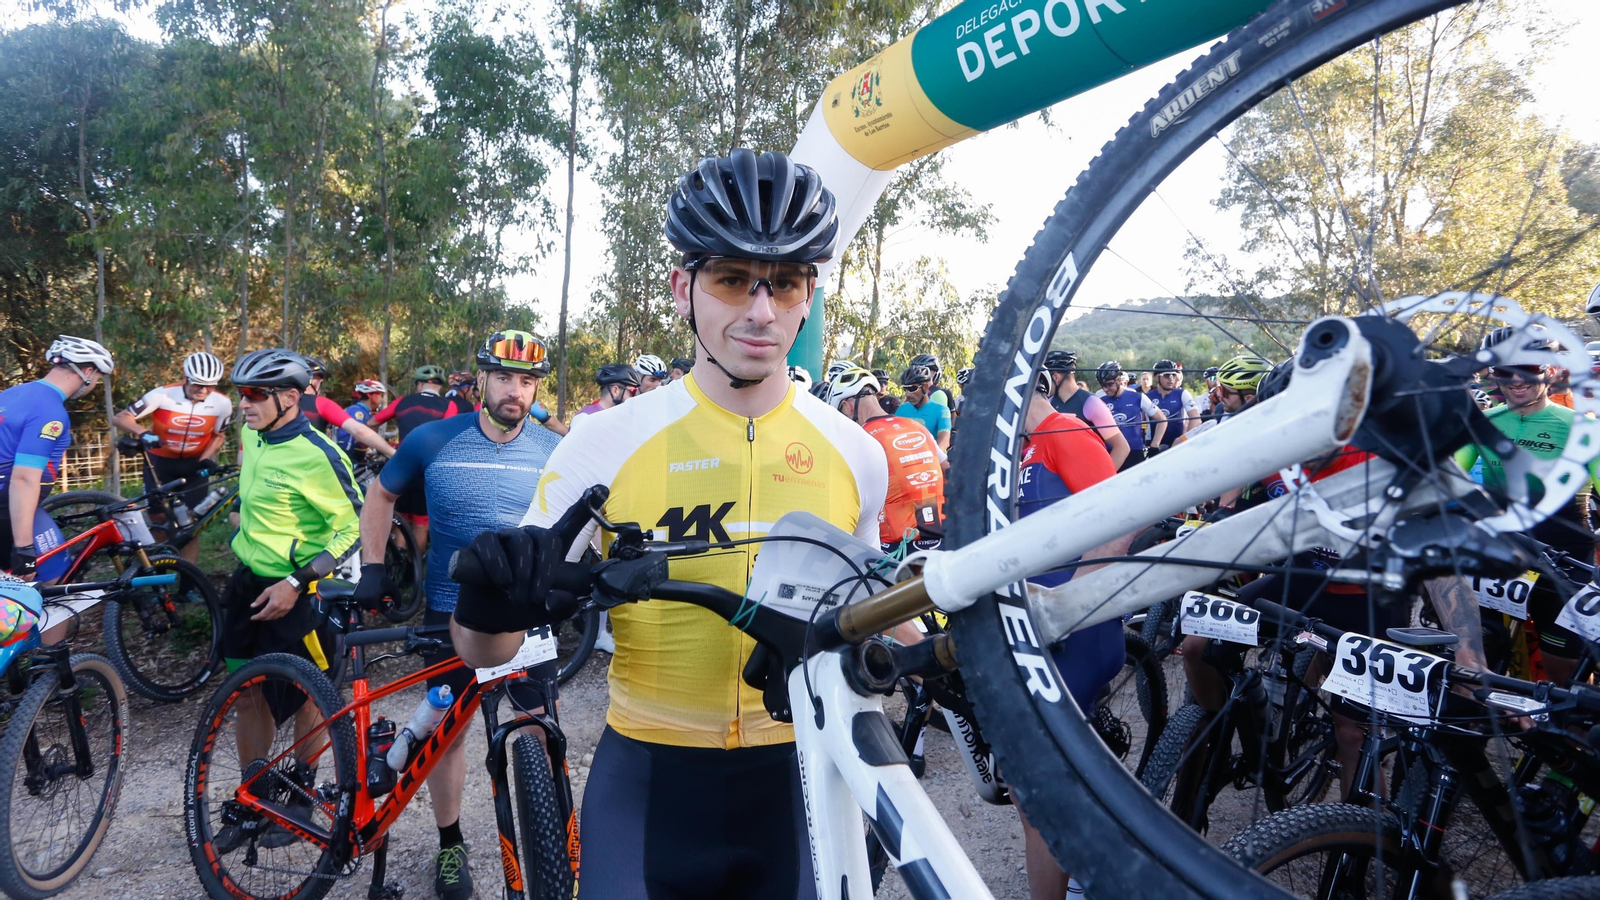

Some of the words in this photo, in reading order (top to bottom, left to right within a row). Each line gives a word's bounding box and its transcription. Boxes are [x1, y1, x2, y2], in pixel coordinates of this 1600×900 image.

[956, 0, 1022, 40] DELEGAC
[956, 0, 1146, 83] DEPOR
[1151, 49, 1241, 138] ARDENT
[669, 457, 721, 474] FASTER
[1518, 438, 1555, 450] BIKES
[1186, 595, 1259, 625] 366
[1341, 636, 1436, 693] 353
[954, 713, 993, 784] nnondale
[188, 751, 199, 805] MEZCAL
[798, 750, 813, 828] RACING
